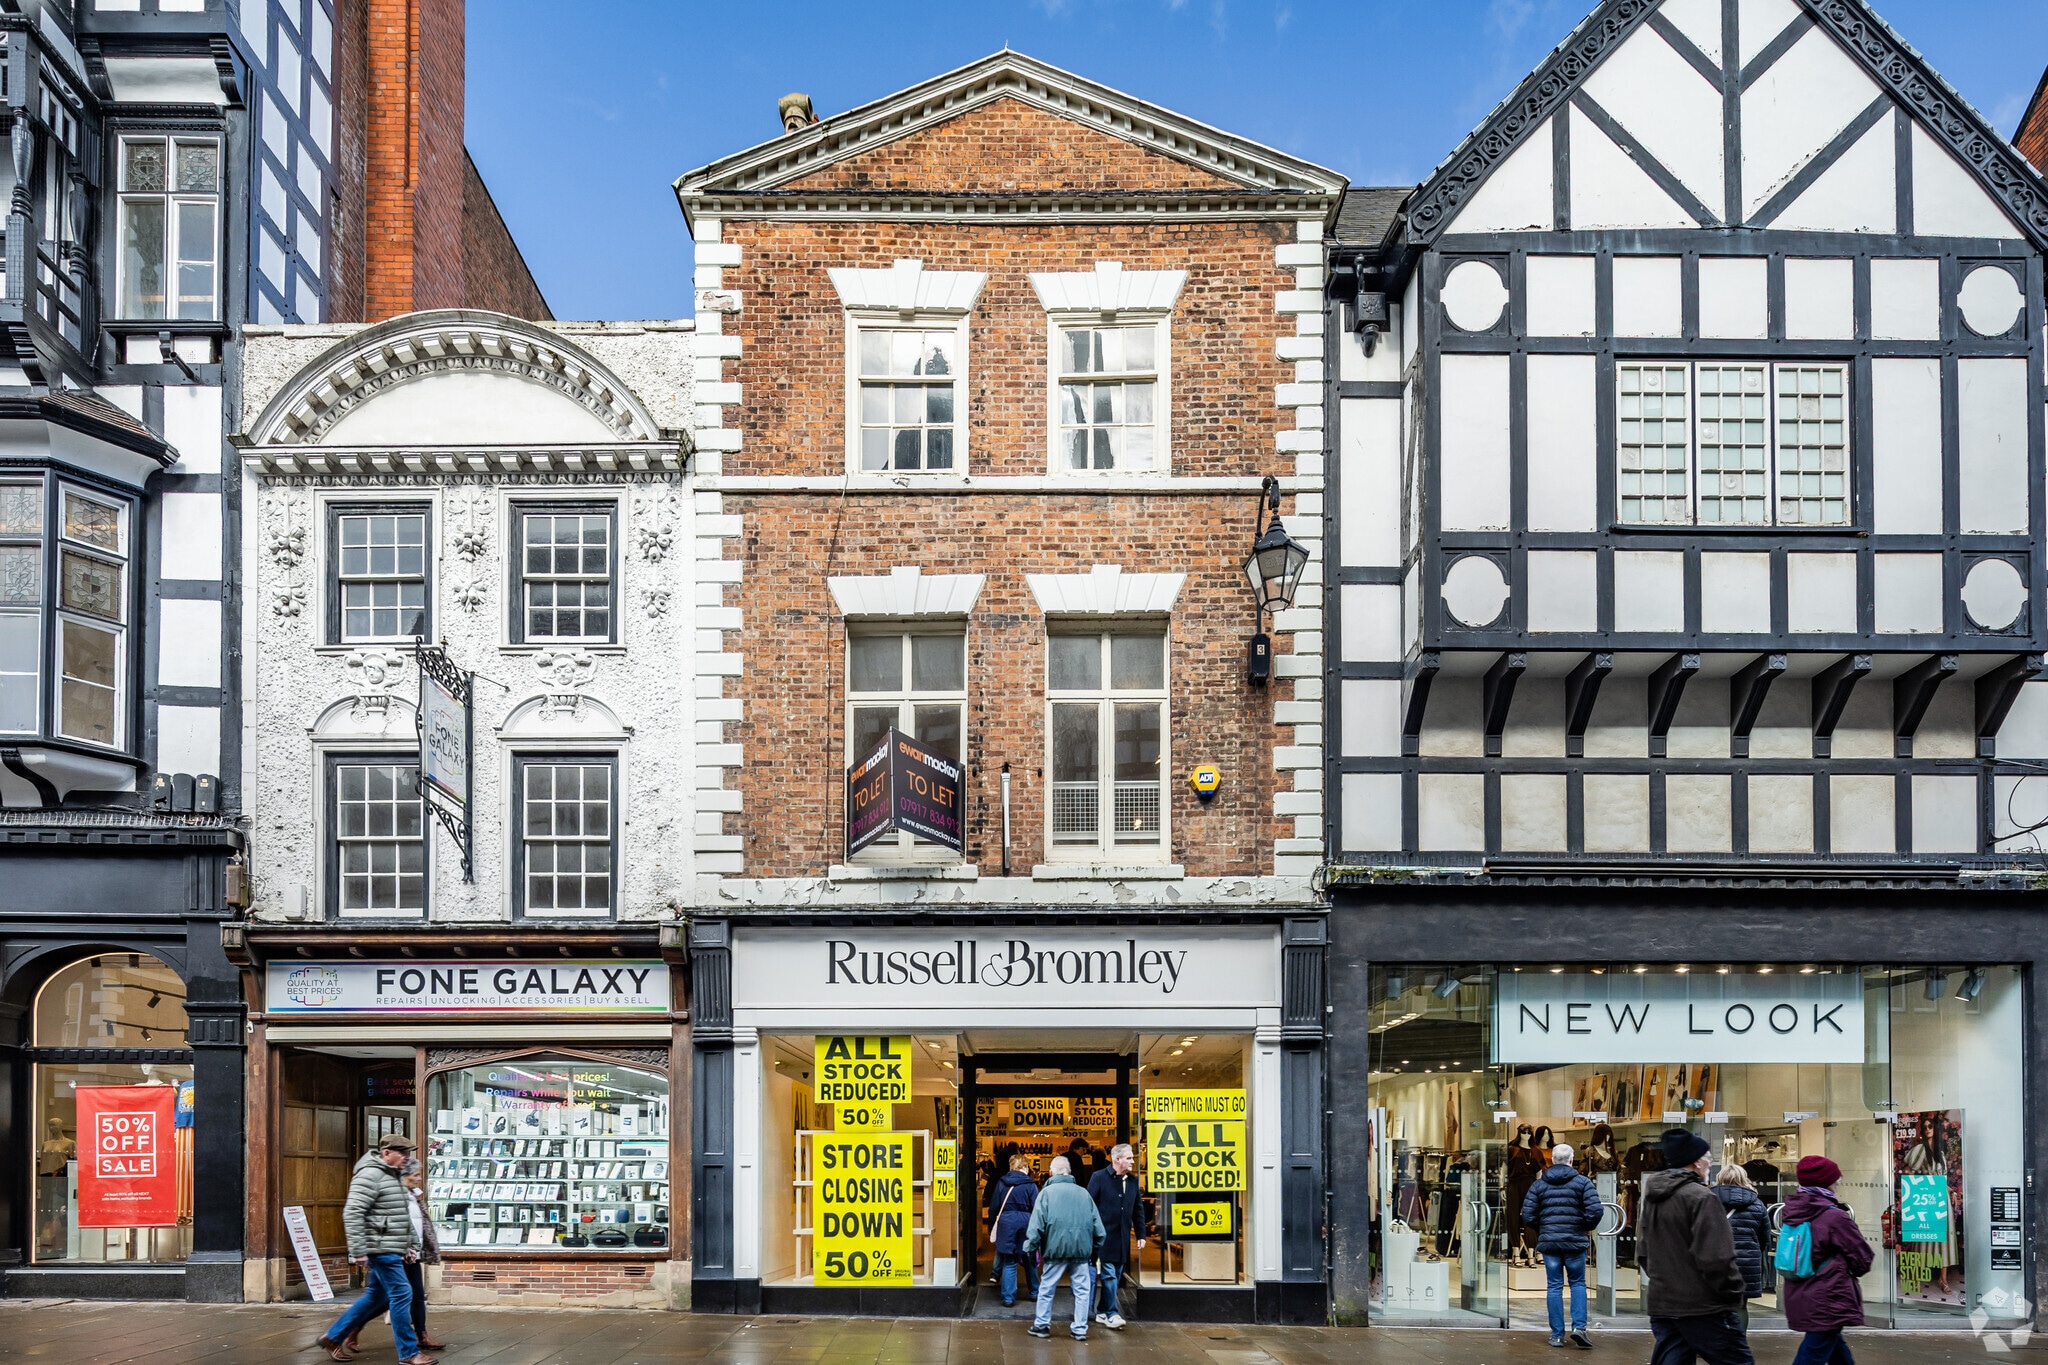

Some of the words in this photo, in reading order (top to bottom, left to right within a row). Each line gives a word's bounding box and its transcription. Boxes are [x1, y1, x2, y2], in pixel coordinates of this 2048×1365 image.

[1258, 646, 1264, 654] 3
[435, 722, 458, 750] FONE
[429, 734, 464, 768] GALAXY
[851, 742, 888, 784] ewanmackay
[900, 742, 960, 782] ewanmackay
[1199, 774, 1213, 782] ADT
[855, 788, 868, 811] TO
[870, 771, 886, 801] LET
[906, 770, 928, 796] TO
[932, 782, 955, 808] LET
[900, 796, 927, 818] 07917
[930, 809, 945, 826] 834
[947, 817, 961, 834] 912
[902, 817, 961, 846] www.ewanmackay.com
[825, 940, 980, 985] Russell
[1004, 940, 1188, 993] Bromley
[376, 969, 478, 995] FONE
[493, 968, 650, 994] GALAXY
[1520, 1003, 1650, 1034] NEW
[1689, 1003, 1844, 1034] LOOK
[824, 1037, 901, 1060] ALL
[488, 1072, 528, 1082] Quality
[573, 1072, 610, 1083] prices!
[824, 1064, 902, 1079] STOCK
[485, 1087, 528, 1098] Repairs
[531, 1088, 560, 1096] while
[587, 1088, 611, 1097] wait
[821, 1083, 905, 1100] REDUCED!
[501, 1101, 550, 1111] Warranty
[1014, 1100, 1063, 1110] CLOSING
[1147, 1096, 1202, 1112] EVERYTHING
[1205, 1097, 1229, 1112] MUST
[1232, 1096, 1246, 1112] GO
[102, 1118, 150, 1133] 50%
[1014, 1113, 1064, 1126] DOWN
[1072, 1116, 1115, 1126] REDUCED!
[1157, 1124, 1235, 1148] ALL
[1896, 1128, 1916, 1138] £19.99
[102, 1136, 150, 1151] OFF
[822, 1144, 903, 1169] STORE
[1156, 1151, 1236, 1168] STOCK
[102, 1160, 151, 1172] SALE
[1154, 1170, 1240, 1189] REDUCED!
[823, 1178, 903, 1203] CLOSING
[1912, 1194, 1936, 1205] 25%
[823, 1212, 902, 1238] DOWN
[824, 1250, 892, 1278] 50%
[1900, 1266, 1931, 1282] STYLED
